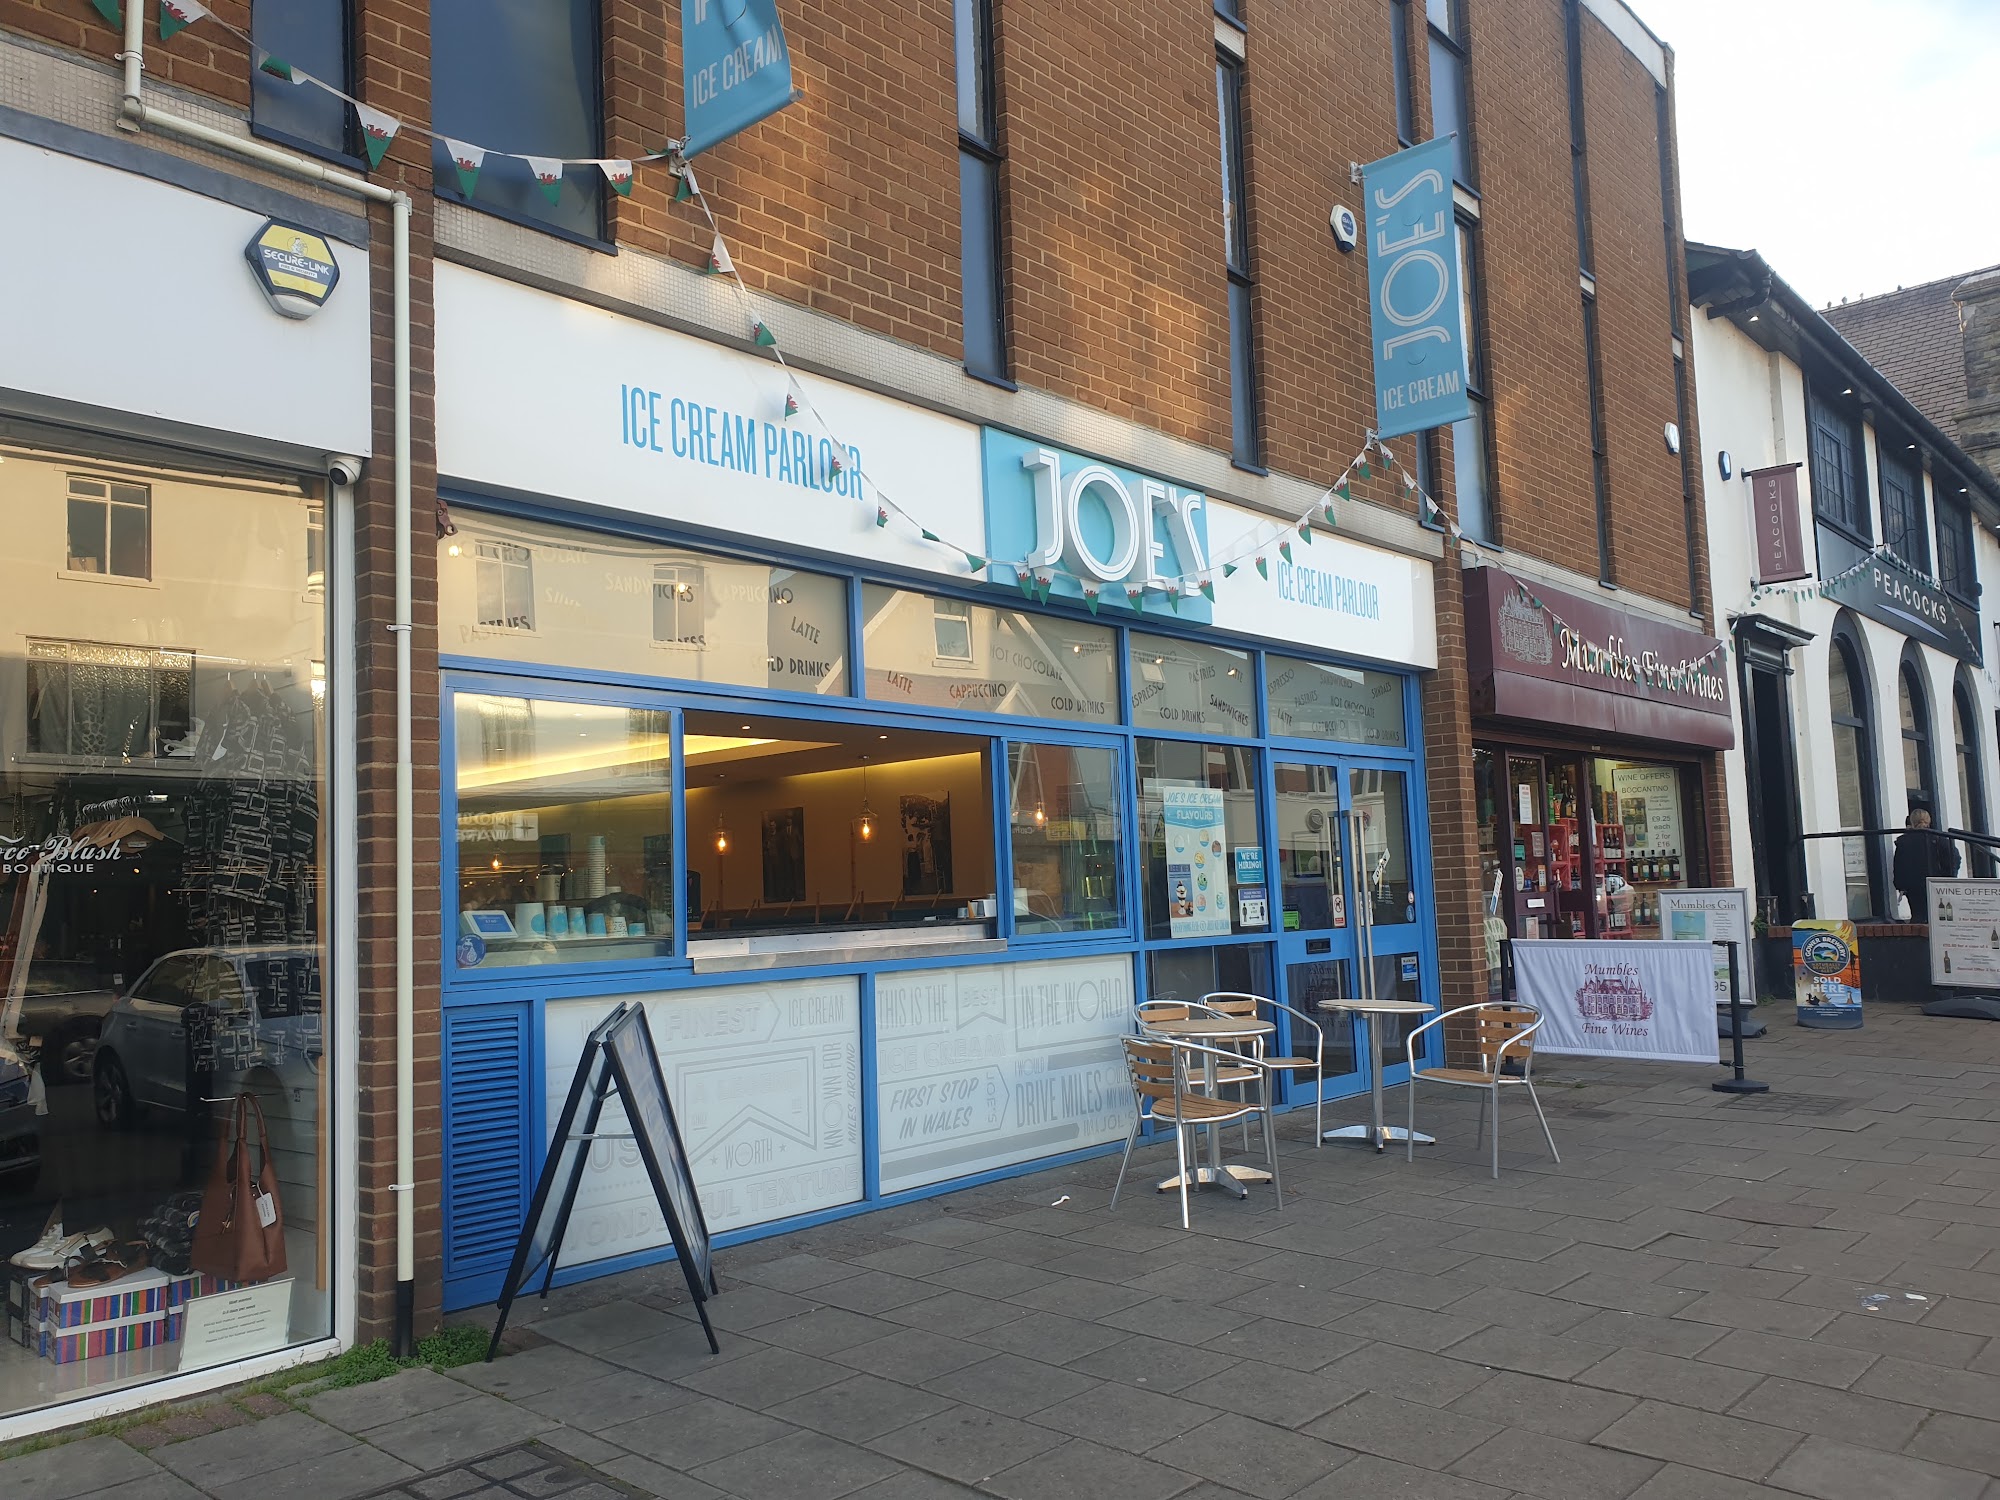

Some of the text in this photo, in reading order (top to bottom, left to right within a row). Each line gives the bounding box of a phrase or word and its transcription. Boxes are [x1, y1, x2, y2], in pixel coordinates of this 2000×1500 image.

[692, 24, 782, 109] ICE CREAM
[264, 249, 330, 275] SECURE-LINK
[1375, 169, 1451, 361] JOE'S
[1384, 370, 1459, 411] ICE CREAM
[622, 384, 663, 452] ICE
[671, 397, 757, 475] CREAM
[1022, 447, 1207, 598] JOE'S
[1768, 479, 1784, 571] PEACOCKS
[1276, 560, 1380, 621] ICE CREAM PARLOUR
[1874, 567, 1947, 625] PEACOCKS
[791, 616, 820, 644] LATTE
[990, 643, 1008, 662] HOT
[790, 658, 831, 678] DRINKS
[1189, 665, 1216, 683] PASTRIES
[1228, 664, 1243, 683] LTTE
[887, 670, 913, 694] LATTE
[949, 683, 1006, 699] CAPPUCCINO
[1268, 668, 1295, 695] ESPRESSO
[1051, 696, 1073, 712] COLD
[1160, 707, 1205, 723] COLD DRINKS
[1210, 694, 1248, 726] SANDWICHES
[1640, 772, 1671, 780] OFFERS
[1166, 792, 1185, 802] JOE'S
[1187, 793, 1198, 803] ICE
[1176, 810, 1213, 820] FLAVOURS
[0, 835, 121, 860] co Blush
[1241, 851, 1258, 860] WE'RE
[2, 863, 94, 873] BOUTIQUE
[1670, 899, 1736, 909] Mumbles Gin
[1936, 887, 1961, 895] WINE
[1805, 936, 1846, 958] GOWER BREWERY
[1584, 962, 1638, 976] Mumbles
[1813, 976, 1841, 984] SOLD
[962, 984, 999, 1008] BEST
[1811, 984, 1845, 993] HERE
[788, 994, 844, 1028] ICE CREAM
[877, 983, 948, 1030] THIS IS THE
[1021, 978, 1122, 1030] IN THE WORLD
[664, 1001, 760, 1042] FINEST
[1582, 1022, 1649, 1037] Fine Wines
[879, 1033, 1006, 1076] ICE CREAM
[1018, 1057, 1044, 1076] WOULD
[823, 1041, 844, 1150] KNOWN FOR
[845, 1042, 858, 1144] MILES AROUND
[889, 1076, 980, 1112] FIRST STOP
[986, 1071, 997, 1123] JOE'S
[1015, 1069, 1103, 1128] DRIVE MILES
[1106, 1088, 1116, 1109] MY
[899, 1106, 974, 1139] IN WALES
[725, 1138, 773, 1170] WORTH
[746, 1162, 859, 1212] TEXTURE
